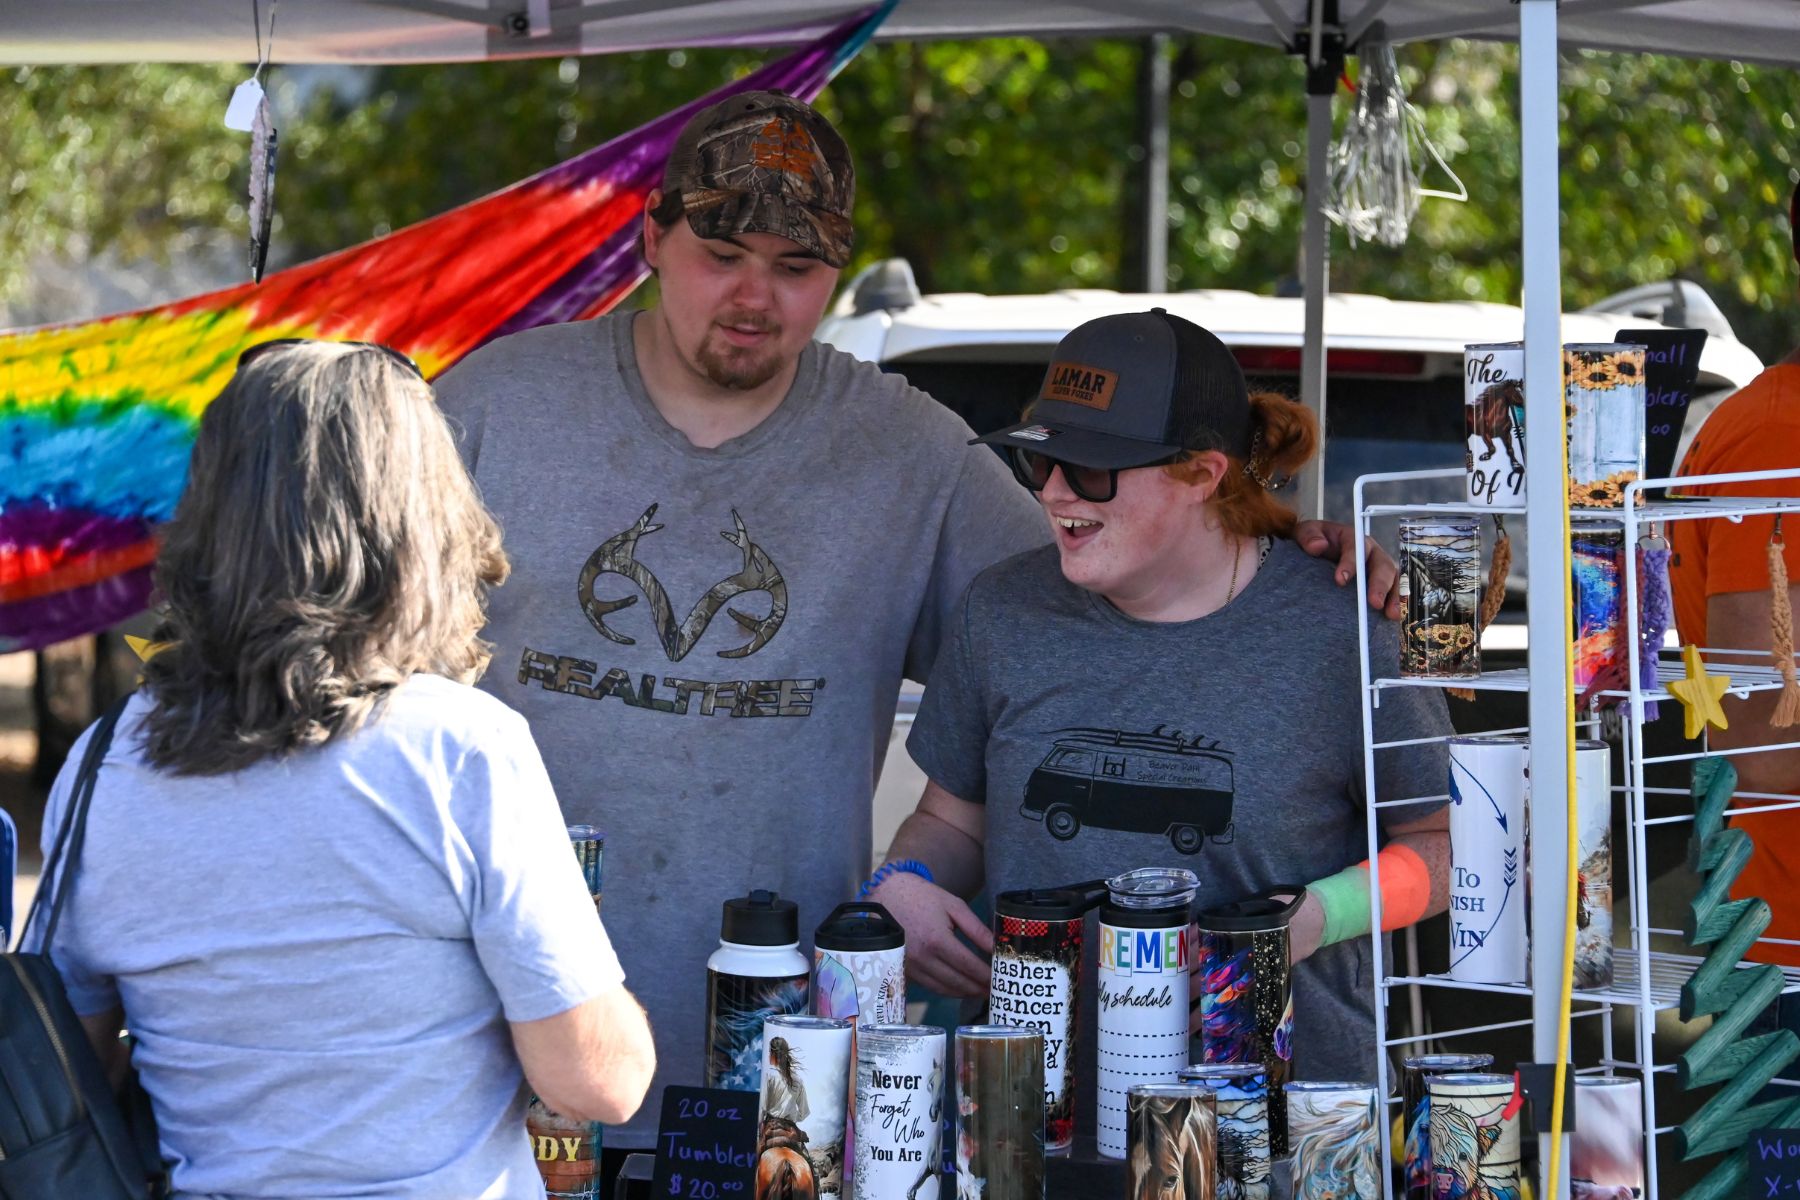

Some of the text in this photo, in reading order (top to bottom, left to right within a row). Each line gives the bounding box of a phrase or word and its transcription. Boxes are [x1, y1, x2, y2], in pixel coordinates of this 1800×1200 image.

[1052, 367, 1106, 393] LAMAR
[1467, 353, 1508, 385] The
[1471, 469, 1501, 504] Of
[517, 647, 816, 717] REALTREE
[1454, 867, 1481, 888] To
[993, 956, 1057, 980] dasher
[991, 974, 1057, 998] dancer
[1111, 984, 1173, 1008] schedule
[990, 993, 1064, 1015] prancer
[871, 1069, 922, 1090] Never
[679, 1097, 742, 1120] 20 oz
[869, 1093, 912, 1129] Forget
[894, 1116, 925, 1144] Who
[661, 1131, 757, 1168] Tumbler
[870, 1146, 922, 1162] You Are
